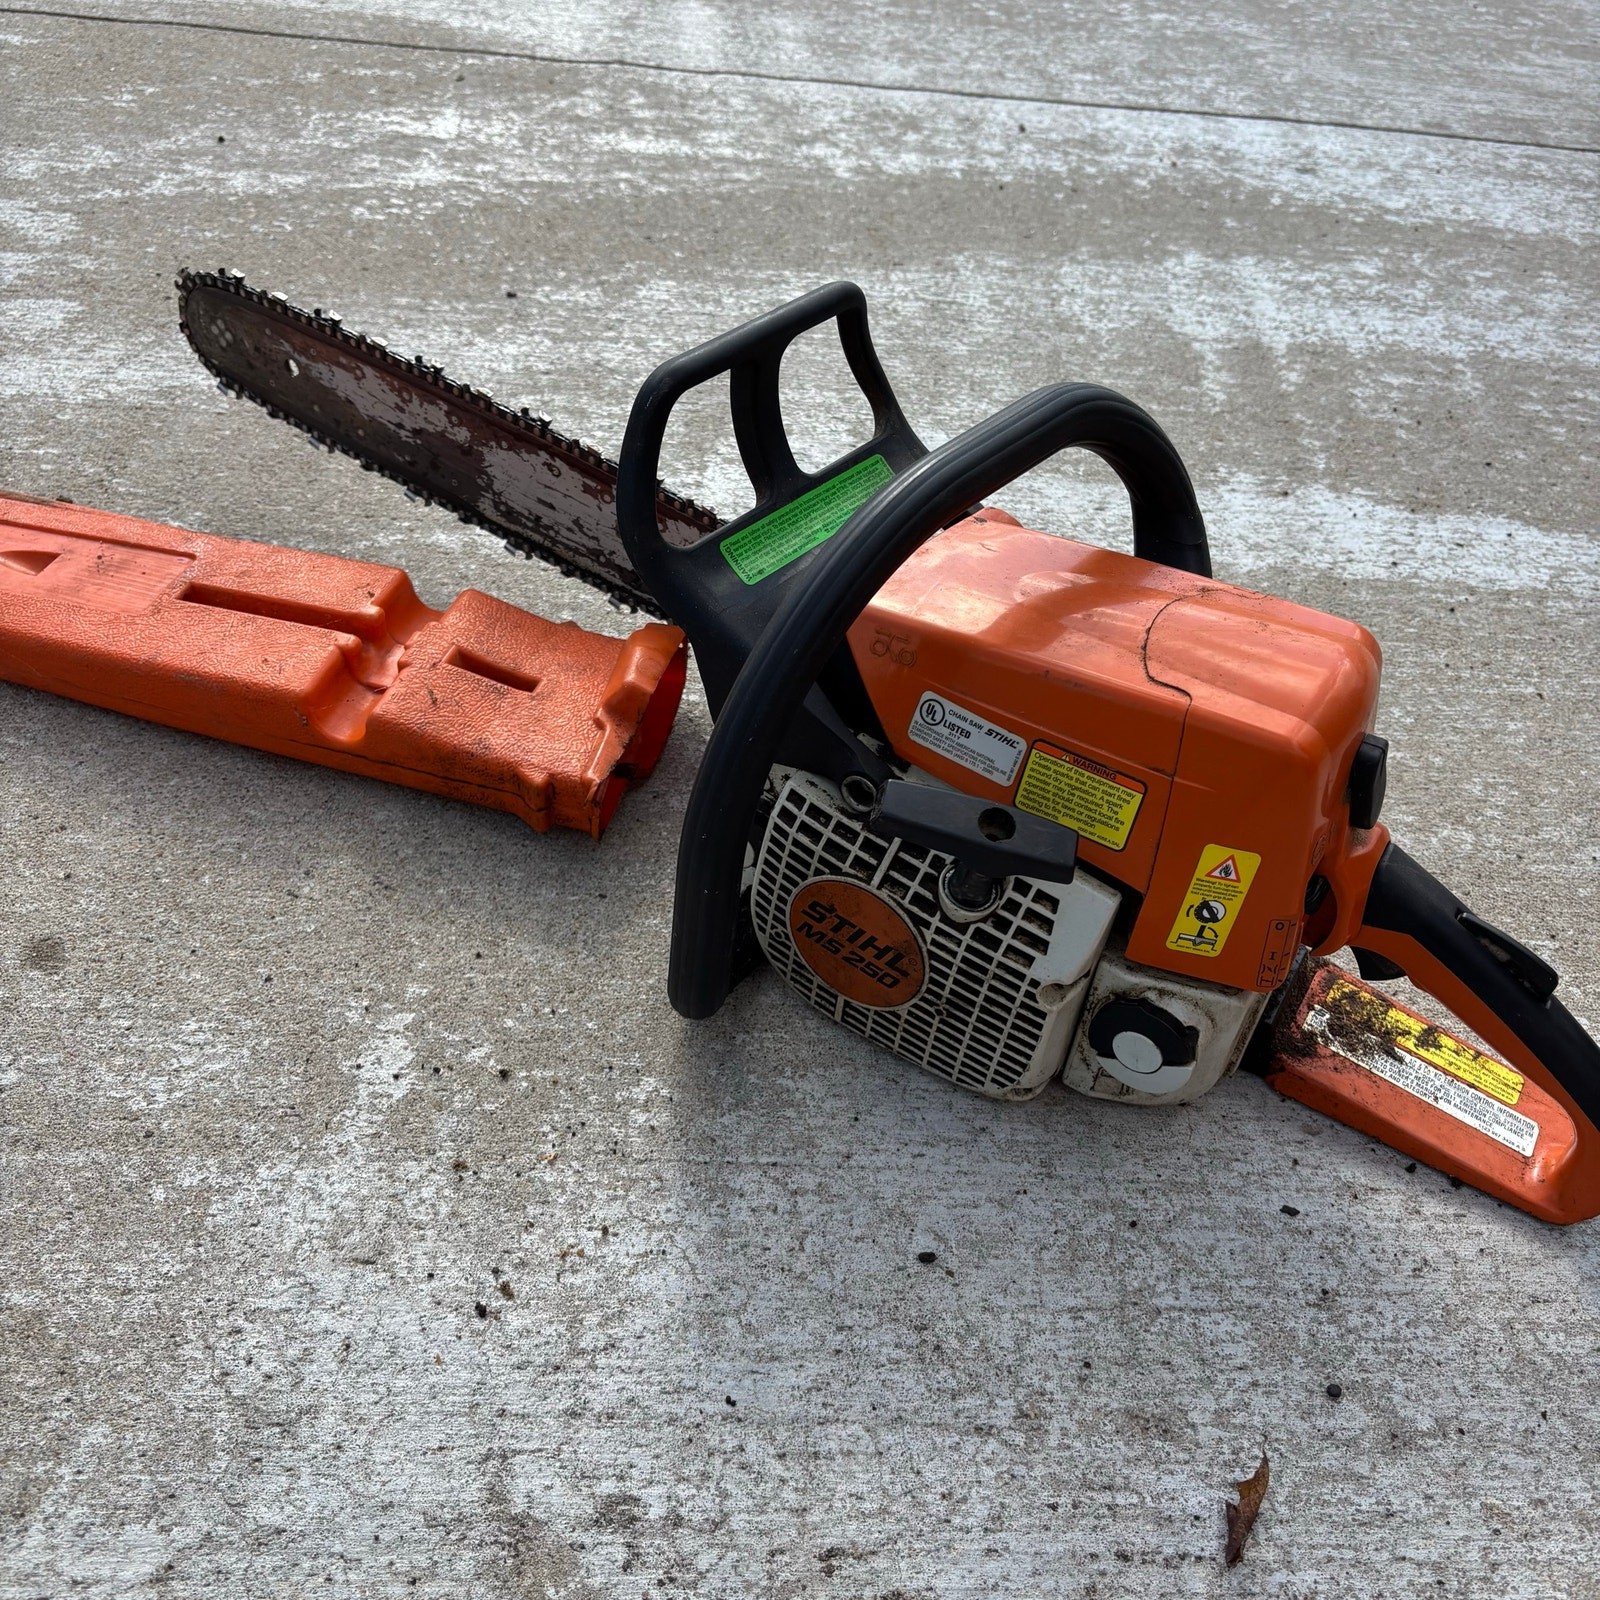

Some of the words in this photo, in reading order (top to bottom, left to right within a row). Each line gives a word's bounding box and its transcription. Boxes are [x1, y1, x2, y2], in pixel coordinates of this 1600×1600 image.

[943, 719, 971, 740] LISTED
[948, 709, 968, 723] CHAIN
[969, 719, 984, 731] SAW
[984, 727, 1018, 749] STIHL
[909, 730, 929, 743] POWERED
[929, 739, 942, 749] CHAIN
[941, 746, 954, 755] SAWS
[912, 725, 933, 738] STANDARD
[933, 735, 947, 746] SAFETY
[947, 743, 978, 761] SPECIFICATIONS
[978, 758, 987, 766] FOR
[986, 762, 1007, 776] GASOLINE
[918, 722, 944, 738] ACCORDANCE
[945, 736, 955, 744] WITH
[955, 741, 976, 754] AMERICAN
[976, 751, 996, 764] NATIONAL
[1029, 766, 1052, 780] around
[1052, 776, 1064, 785] dry
[1064, 781, 1099, 800] vegetation.
[1105, 798, 1124, 811] spark
[1031, 759, 1052, 772] create
[1052, 768, 1074, 782] sparks
[1074, 777, 1087, 787] that
[1088, 784, 1100, 792] can
[1101, 788, 1116, 799] start
[1116, 794, 1131, 805] fires
[1034, 752, 1066, 771] Operation
[1066, 765, 1074, 773] of
[1074, 768, 1085, 778] this
[1085, 773, 1121, 794] equipment
[1120, 789, 1136, 801] may
[1071, 756, 1117, 781] WARNING
[1020, 793, 1044, 808] relating
[1051, 806, 1062, 815] fire
[1062, 811, 1096, 830] prevention
[1022, 786, 1051, 804] agencies
[1051, 799, 1061, 807] for
[1061, 803, 1076, 813] laws
[1084, 812, 1120, 833] regulations
[1024, 780, 1051, 796] operator
[1052, 791, 1073, 804] should
[1074, 800, 1098, 814] contact
[1098, 810, 1114, 821] local
[1114, 817, 1125, 826] fire
[1027, 773, 1052, 787] arrester
[1052, 784, 1066, 794] may
[1067, 789, 1077, 797] be
[1077, 794, 1105, 810] required.
[1106, 806, 1119, 815] The
[797, 921, 845, 955] MS
[842, 950, 900, 989] 250
[801, 901, 909, 979] STIHL
[1388, 1073, 1401, 1083] AND
[1408, 1058, 1417, 1067] AG
[1443, 1077, 1470, 1096] EMISSION
[1470, 1091, 1496, 1110] CONTROL
[1496, 1105, 1535, 1131] INFORMATION
[1430, 1084, 1442, 1094] FOR
[1459, 1100, 1487, 1119] EMISSION
[1453, 1091, 1478, 1108] EMISSION
[1479, 1105, 1502, 1121] CONTROL
[1503, 1118, 1524, 1133] SYSTEM
